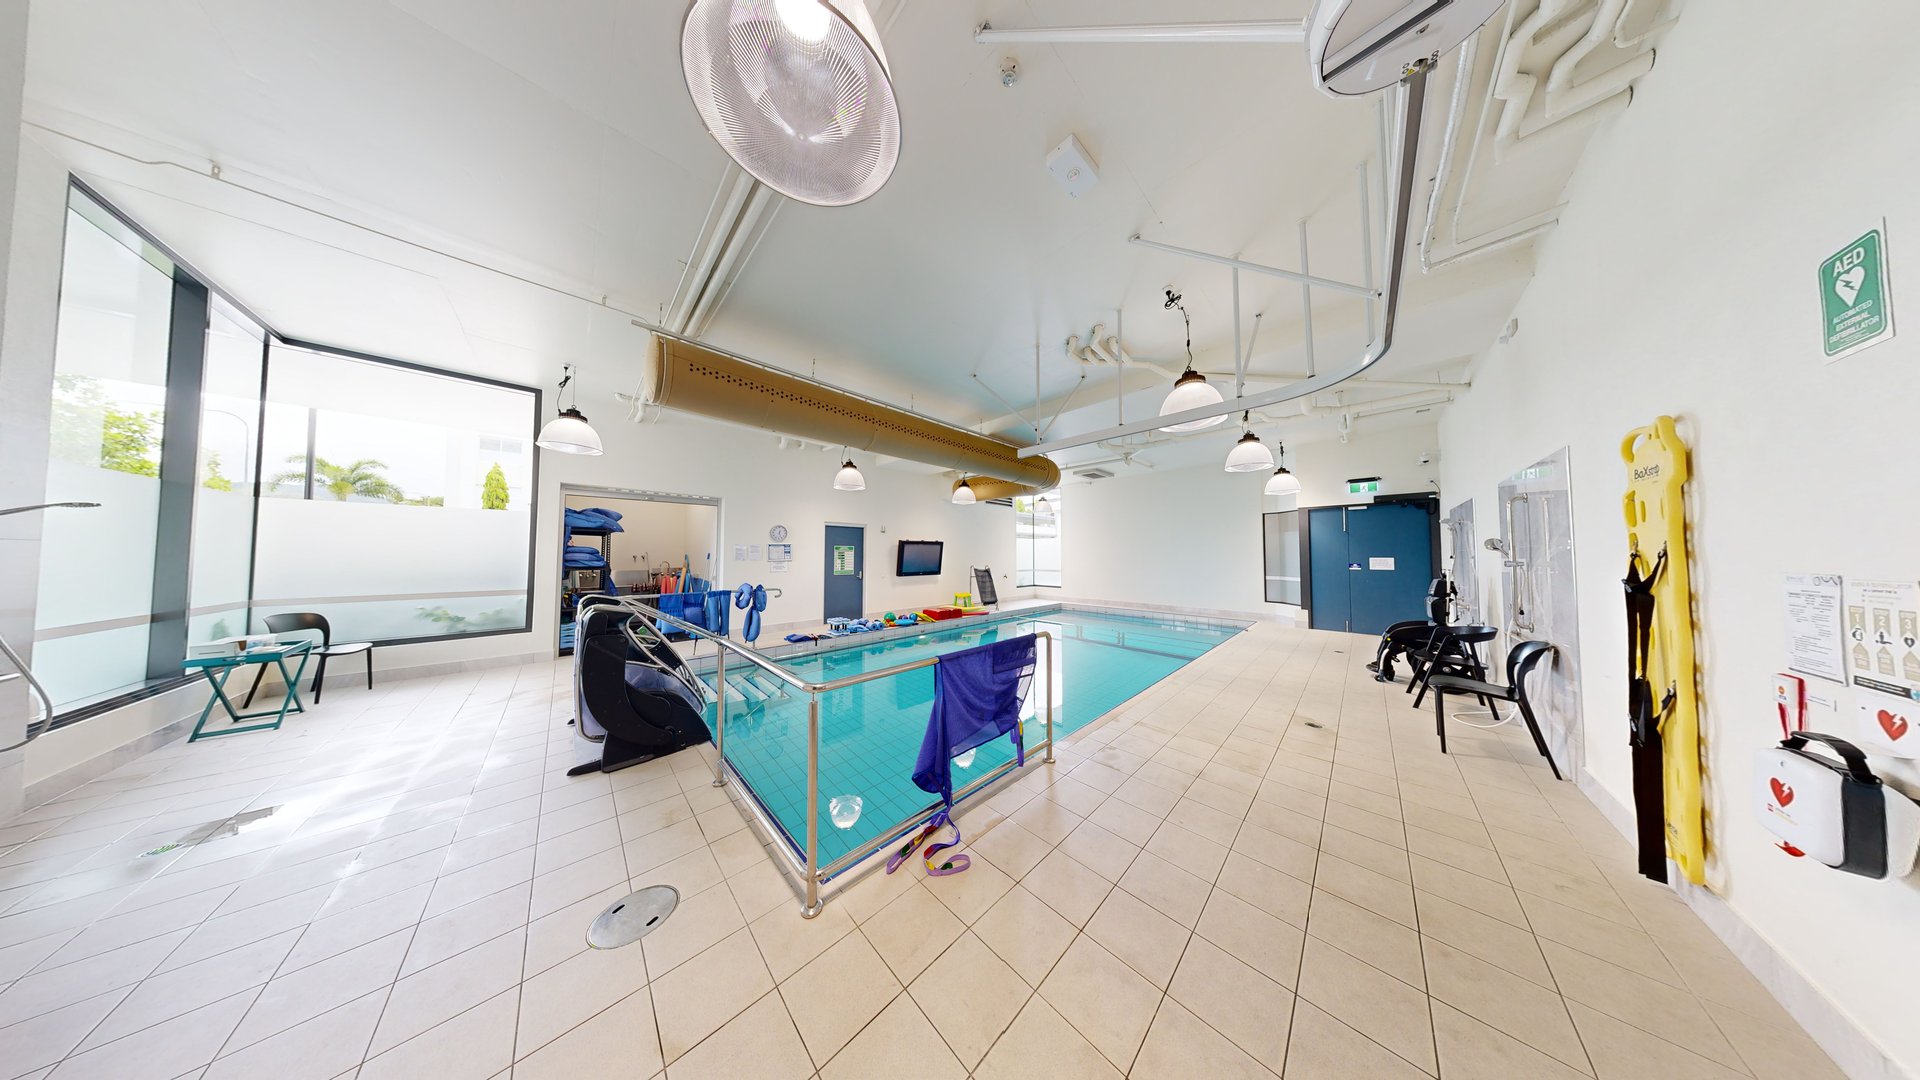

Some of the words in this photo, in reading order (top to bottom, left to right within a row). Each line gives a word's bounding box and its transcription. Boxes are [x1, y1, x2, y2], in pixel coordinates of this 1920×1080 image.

[1833, 247, 1865, 277] AED
[1833, 300, 1873, 325] AUTOMATED
[1829, 315, 1880, 343] DEFIBRILLATOR
[1878, 616, 1886, 626] 2
[1904, 619, 1912, 630] 3
